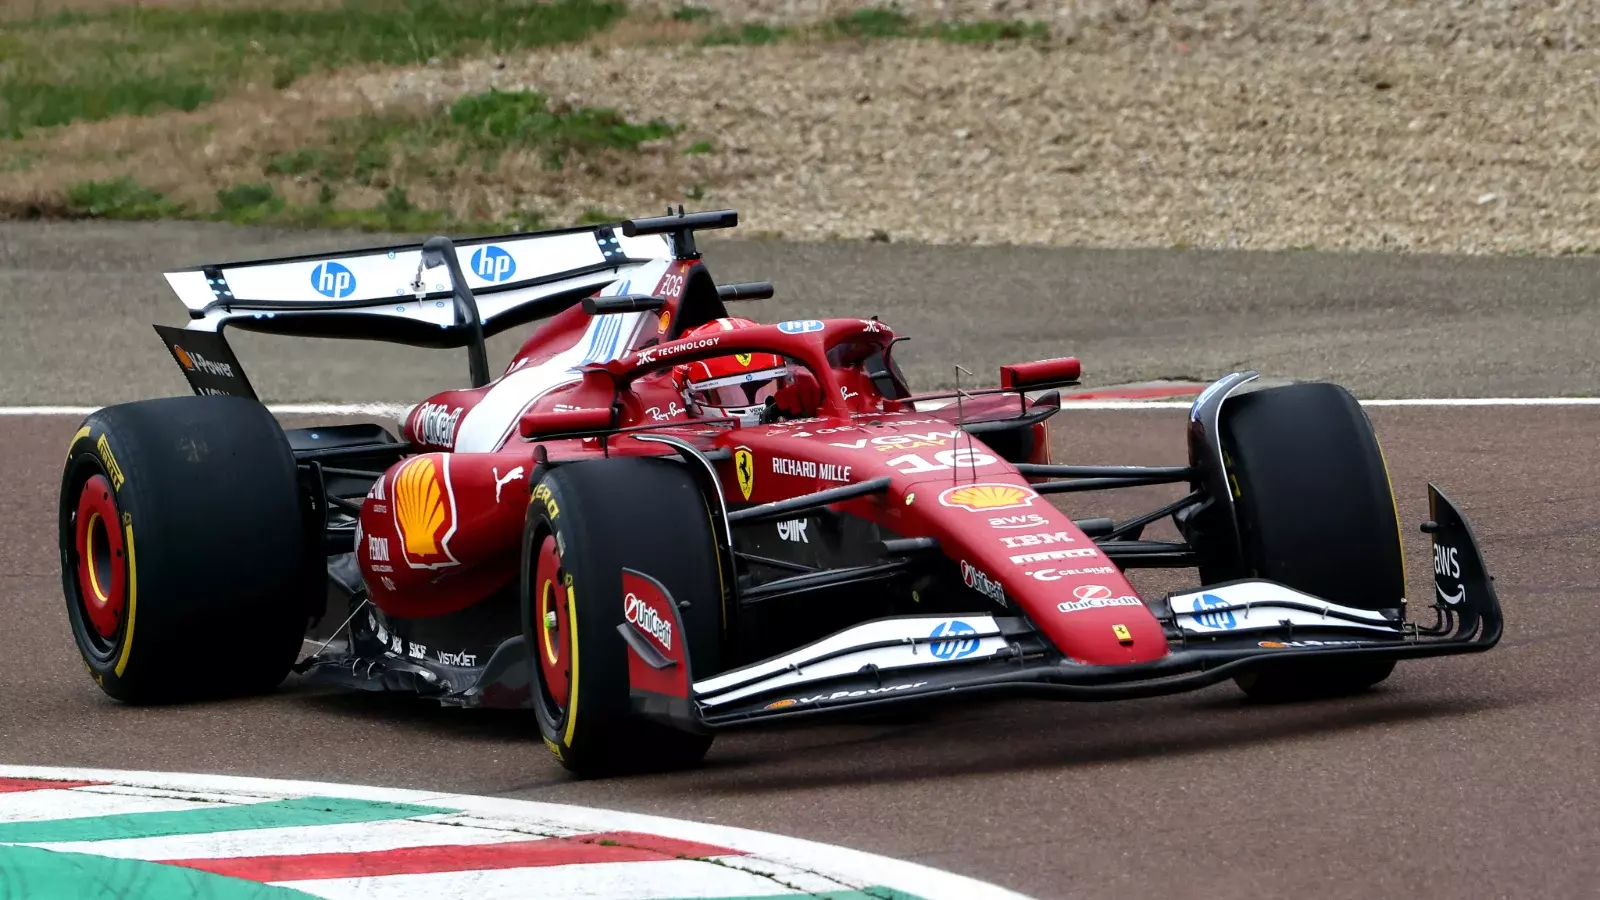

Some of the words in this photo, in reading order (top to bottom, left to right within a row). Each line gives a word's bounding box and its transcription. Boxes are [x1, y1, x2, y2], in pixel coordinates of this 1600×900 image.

[478, 246, 511, 282] hp
[318, 261, 351, 298] hp
[660, 273, 683, 297] ZCG
[658, 337, 720, 356] TECHNOLOGY
[186, 351, 235, 378] V-Power
[645, 401, 687, 421] Ray-Ban
[828, 430, 962, 450] VGW
[873, 439, 947, 452] PLAY
[772, 457, 816, 479] RICHARD
[818, 463, 852, 483] MILLE
[886, 447, 998, 475] 16
[530, 482, 560, 520] ZERO
[988, 513, 1045, 527] aws
[368, 533, 390, 561] PERONI
[999, 531, 1076, 549] IBM
[1009, 548, 1098, 564] PIRELLI
[1434, 543, 1460, 579] aws
[1058, 566, 1114, 576] CELSIUS
[1058, 596, 1143, 612] UniCredit
[1199, 594, 1233, 630] hp
[637, 600, 671, 650] UniCredit
[408, 641, 427, 660] SKF
[936, 620, 976, 660] hp
[436, 648, 477, 667] VISTAJET
[800, 681, 929, 703] V-Power
